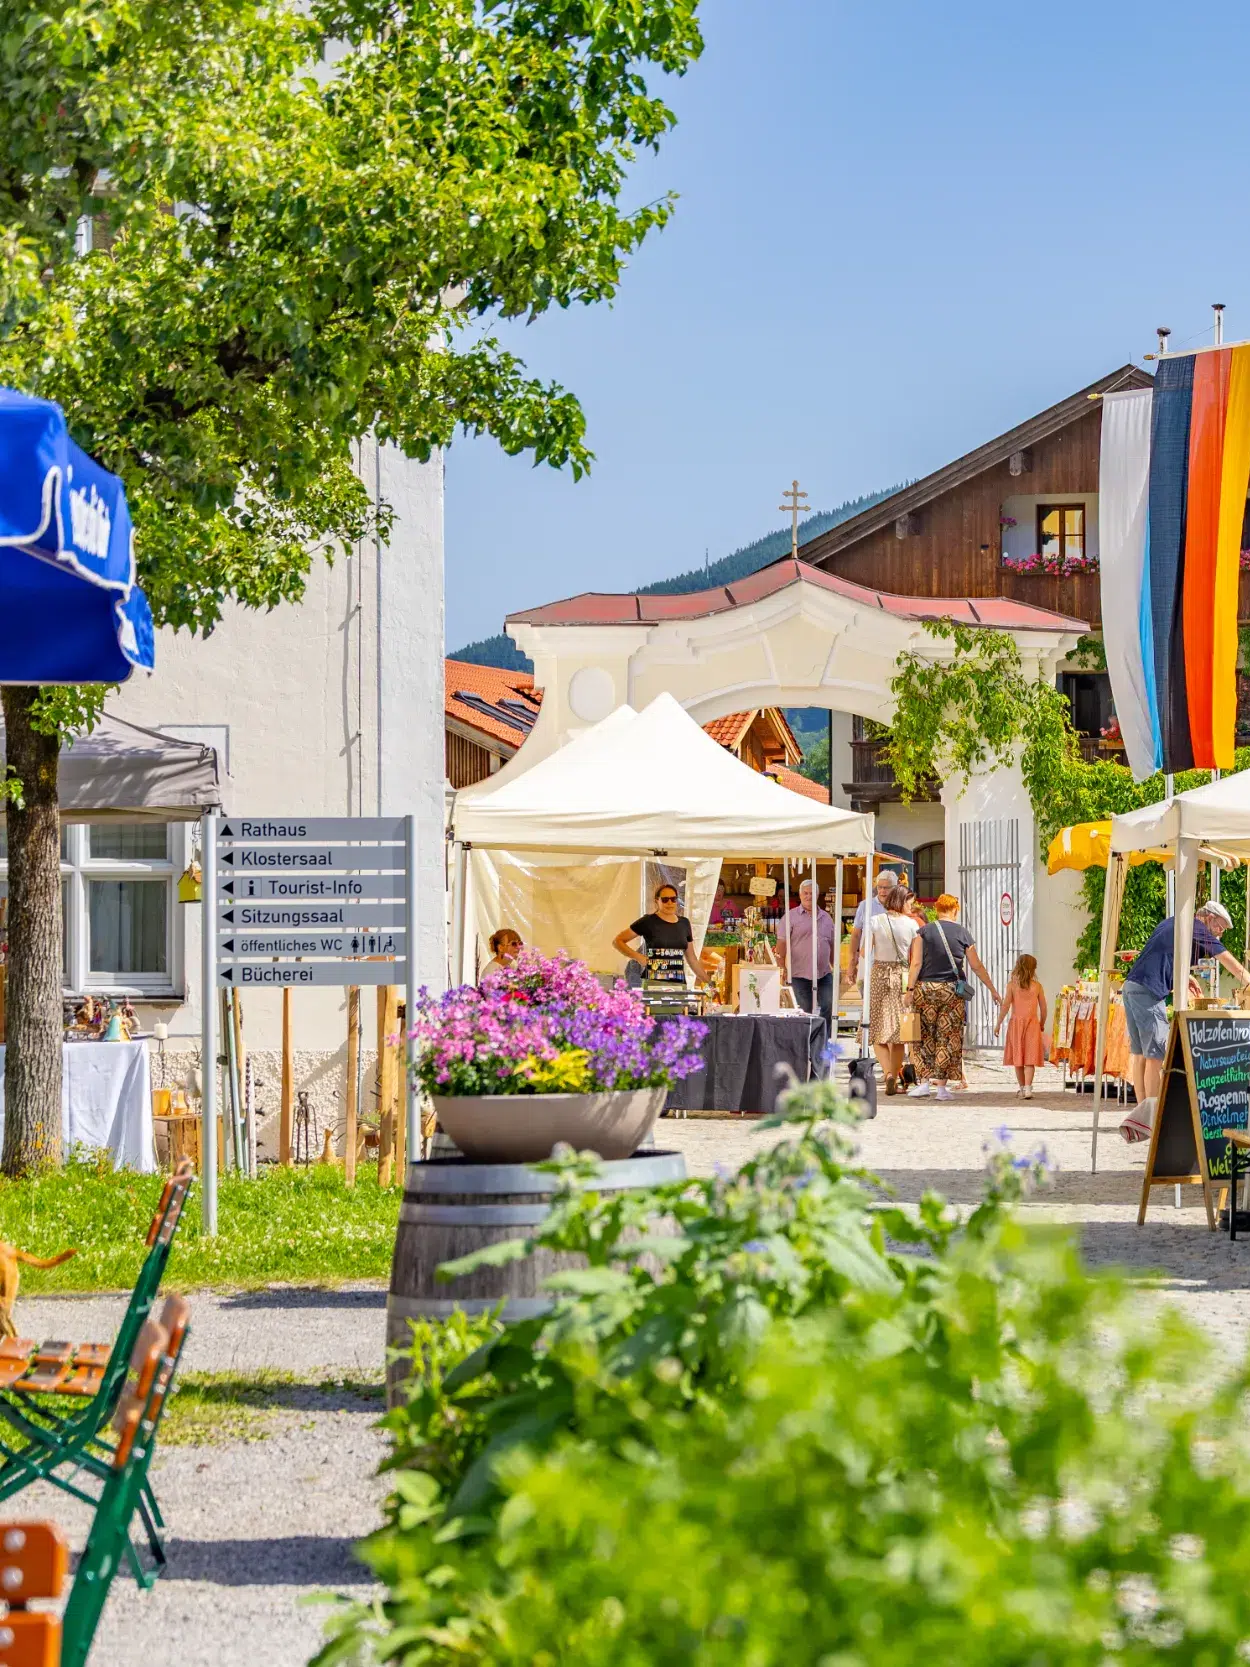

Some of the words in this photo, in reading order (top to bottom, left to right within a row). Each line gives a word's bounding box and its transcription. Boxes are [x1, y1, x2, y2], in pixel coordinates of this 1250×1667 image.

[241, 823, 307, 837] Rathaus
[241, 851, 332, 866] Klostersaal
[268, 880, 362, 895] Tourist-Info
[241, 909, 344, 926] Sitzungssaal
[241, 938, 316, 952] öffentliches
[320, 939, 343, 951] WC
[242, 966, 313, 982] Bücherei
